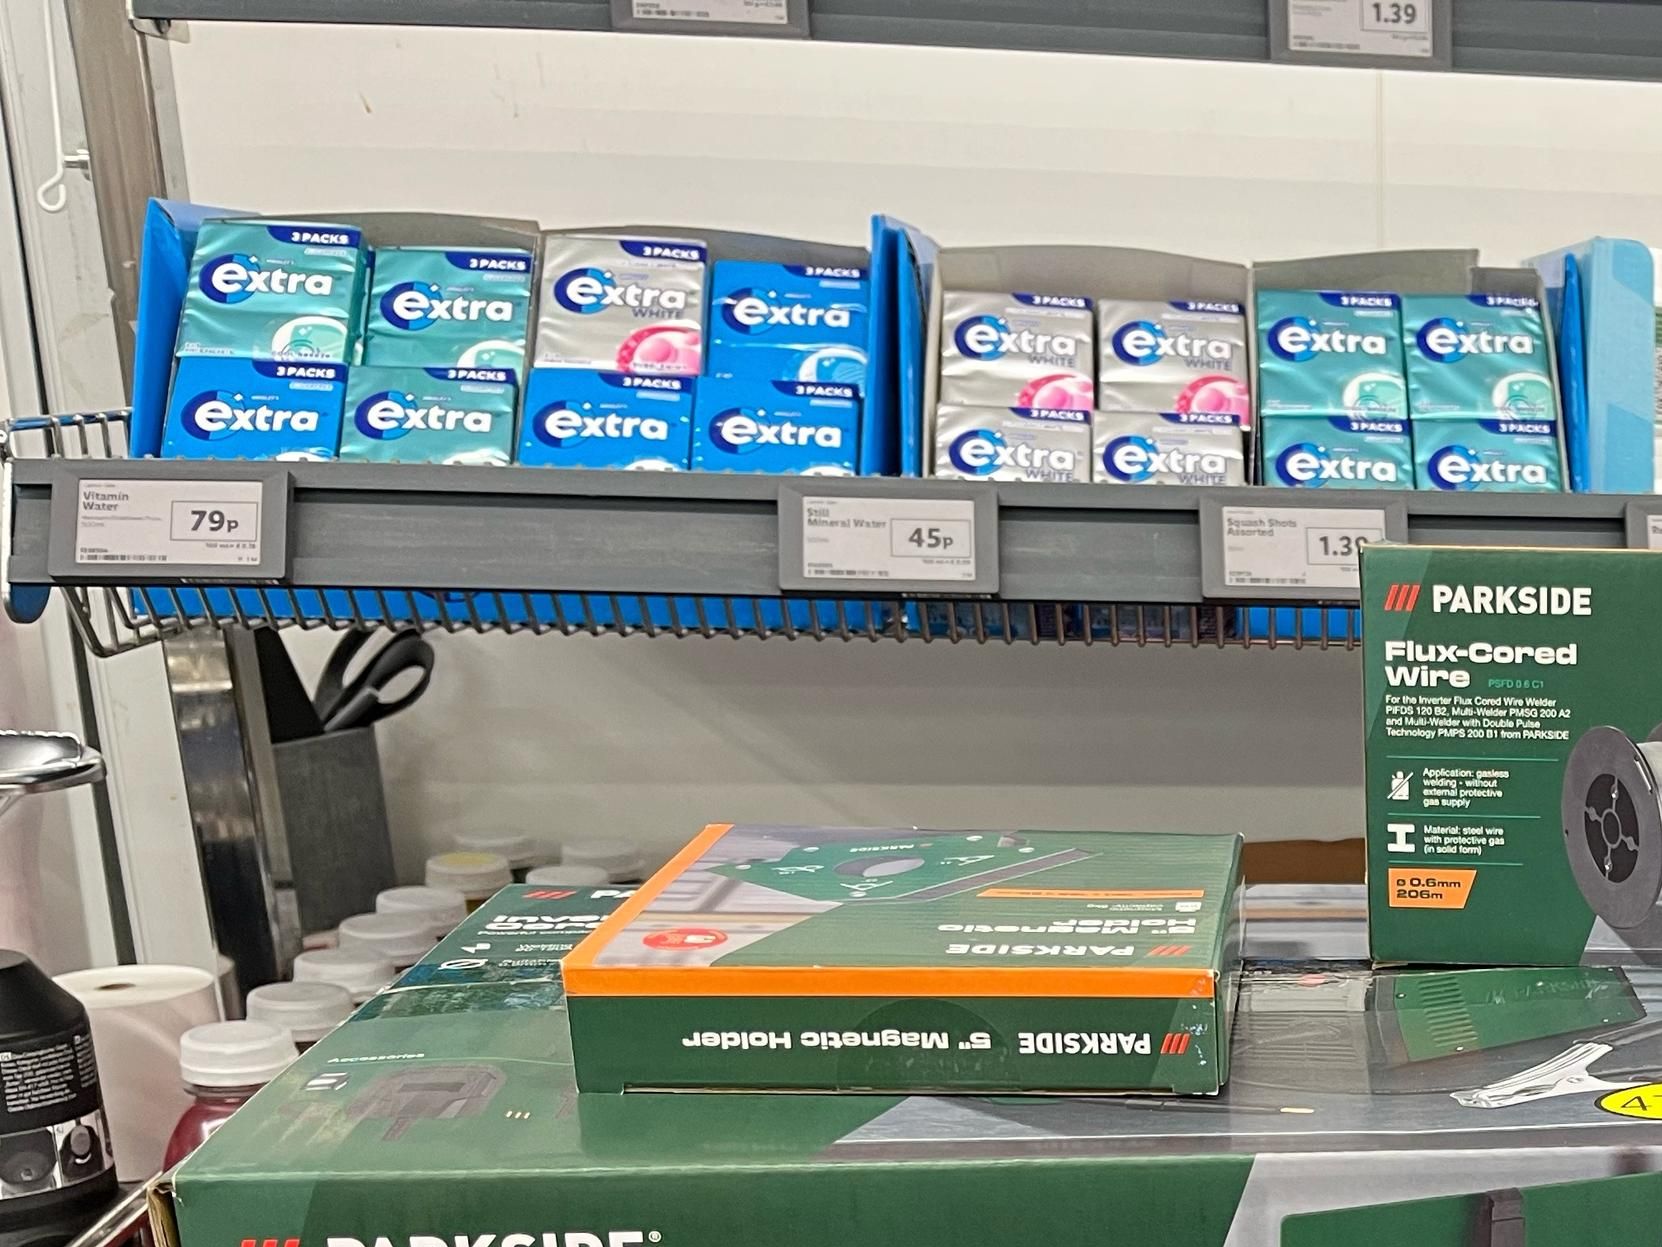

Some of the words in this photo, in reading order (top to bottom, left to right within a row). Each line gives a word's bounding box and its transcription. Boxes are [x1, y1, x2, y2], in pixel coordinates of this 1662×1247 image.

[1372, 2, 1416, 24] 1.39
[291, 232, 302, 243] 3
[302, 232, 349, 245] PACKS
[632, 308, 684, 320] WHITE
[1027, 355, 1075, 368] WHITE
[83, 491, 129, 501] Vitamin
[83, 502, 118, 511] Water
[807, 508, 829, 517] Still
[191, 510, 238, 533] 79p
[807, 518, 851, 528] Mineral
[854, 519, 886, 528] Water
[1227, 518, 1265, 527] Squash
[1268, 519, 1296, 527] Shots
[909, 527, 953, 549] 45p
[1227, 528, 1274, 536] Assorted
[1432, 585, 1592, 616] PARKSIDE
[1385, 640, 1578, 665] Flux-Cored
[1385, 666, 1471, 688] Wire
[1386, 695, 1400, 704] For
[1402, 695, 1416, 704] the
[1419, 695, 1452, 705] Inverter
[1454, 697, 1472, 706] Flux
[1474, 697, 1501, 706] Cored
[1504, 697, 1524, 706] Wire
[1525, 698, 1556, 707] Welder
[1423, 768, 1474, 780] Application:
[1476, 770, 1509, 779] gasless
[1423, 778, 1456, 788] welding
[1465, 779, 1497, 788] without
[1410, 878, 1461, 888] 0.6mm
[1397, 889, 1443, 899] 206m
[945, 943, 1135, 957] PARKSIDE
[683, 1030, 793, 1050] Holder
[800, 1029, 950, 1051] Magnetic
[1018, 1032, 1152, 1056] PARKSIDE
